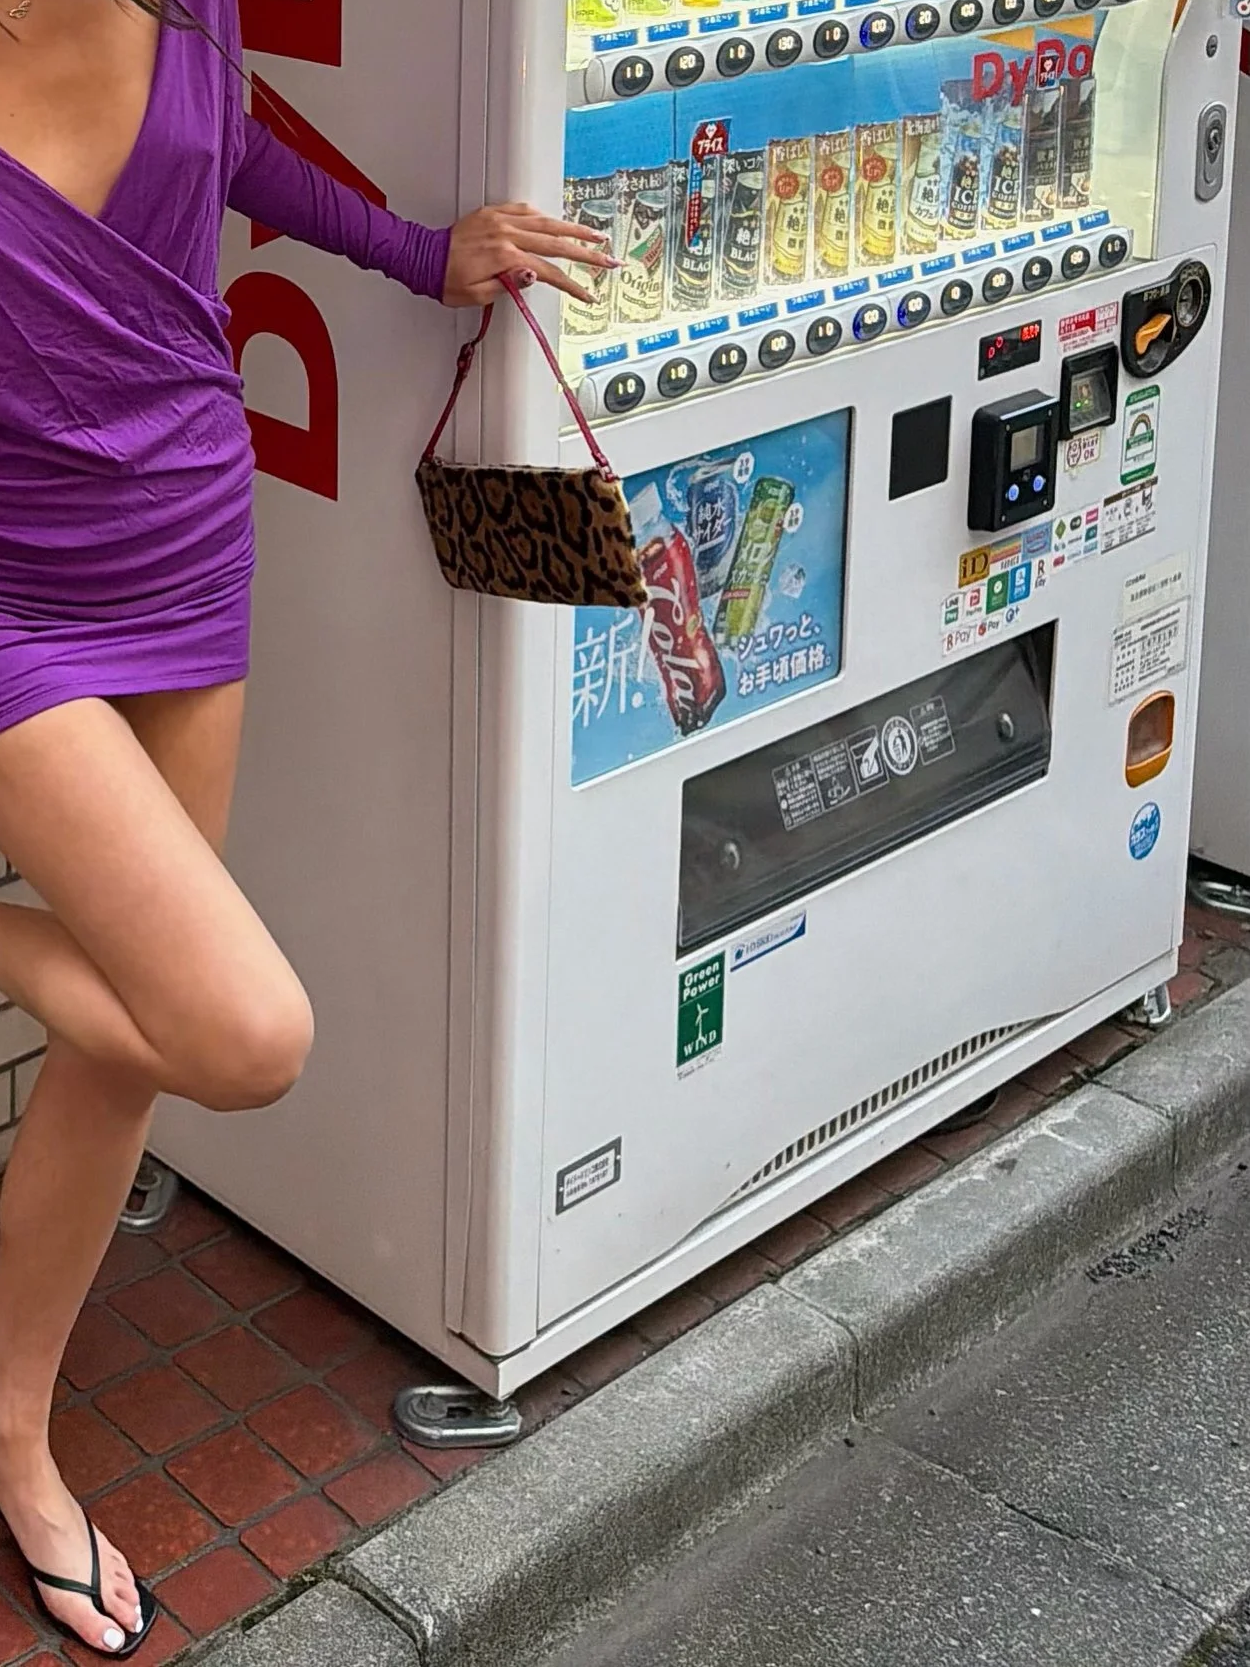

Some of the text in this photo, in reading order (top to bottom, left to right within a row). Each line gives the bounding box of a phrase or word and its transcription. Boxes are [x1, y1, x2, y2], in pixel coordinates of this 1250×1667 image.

[961, 552, 989, 580] iD
[738, 613, 821, 661] シュワっと、
[737, 643, 832, 696] お手頃価格。
[682, 973, 721, 1002] Power
[683, 960, 721, 988] Green
[683, 1029, 718, 1057] WIND
